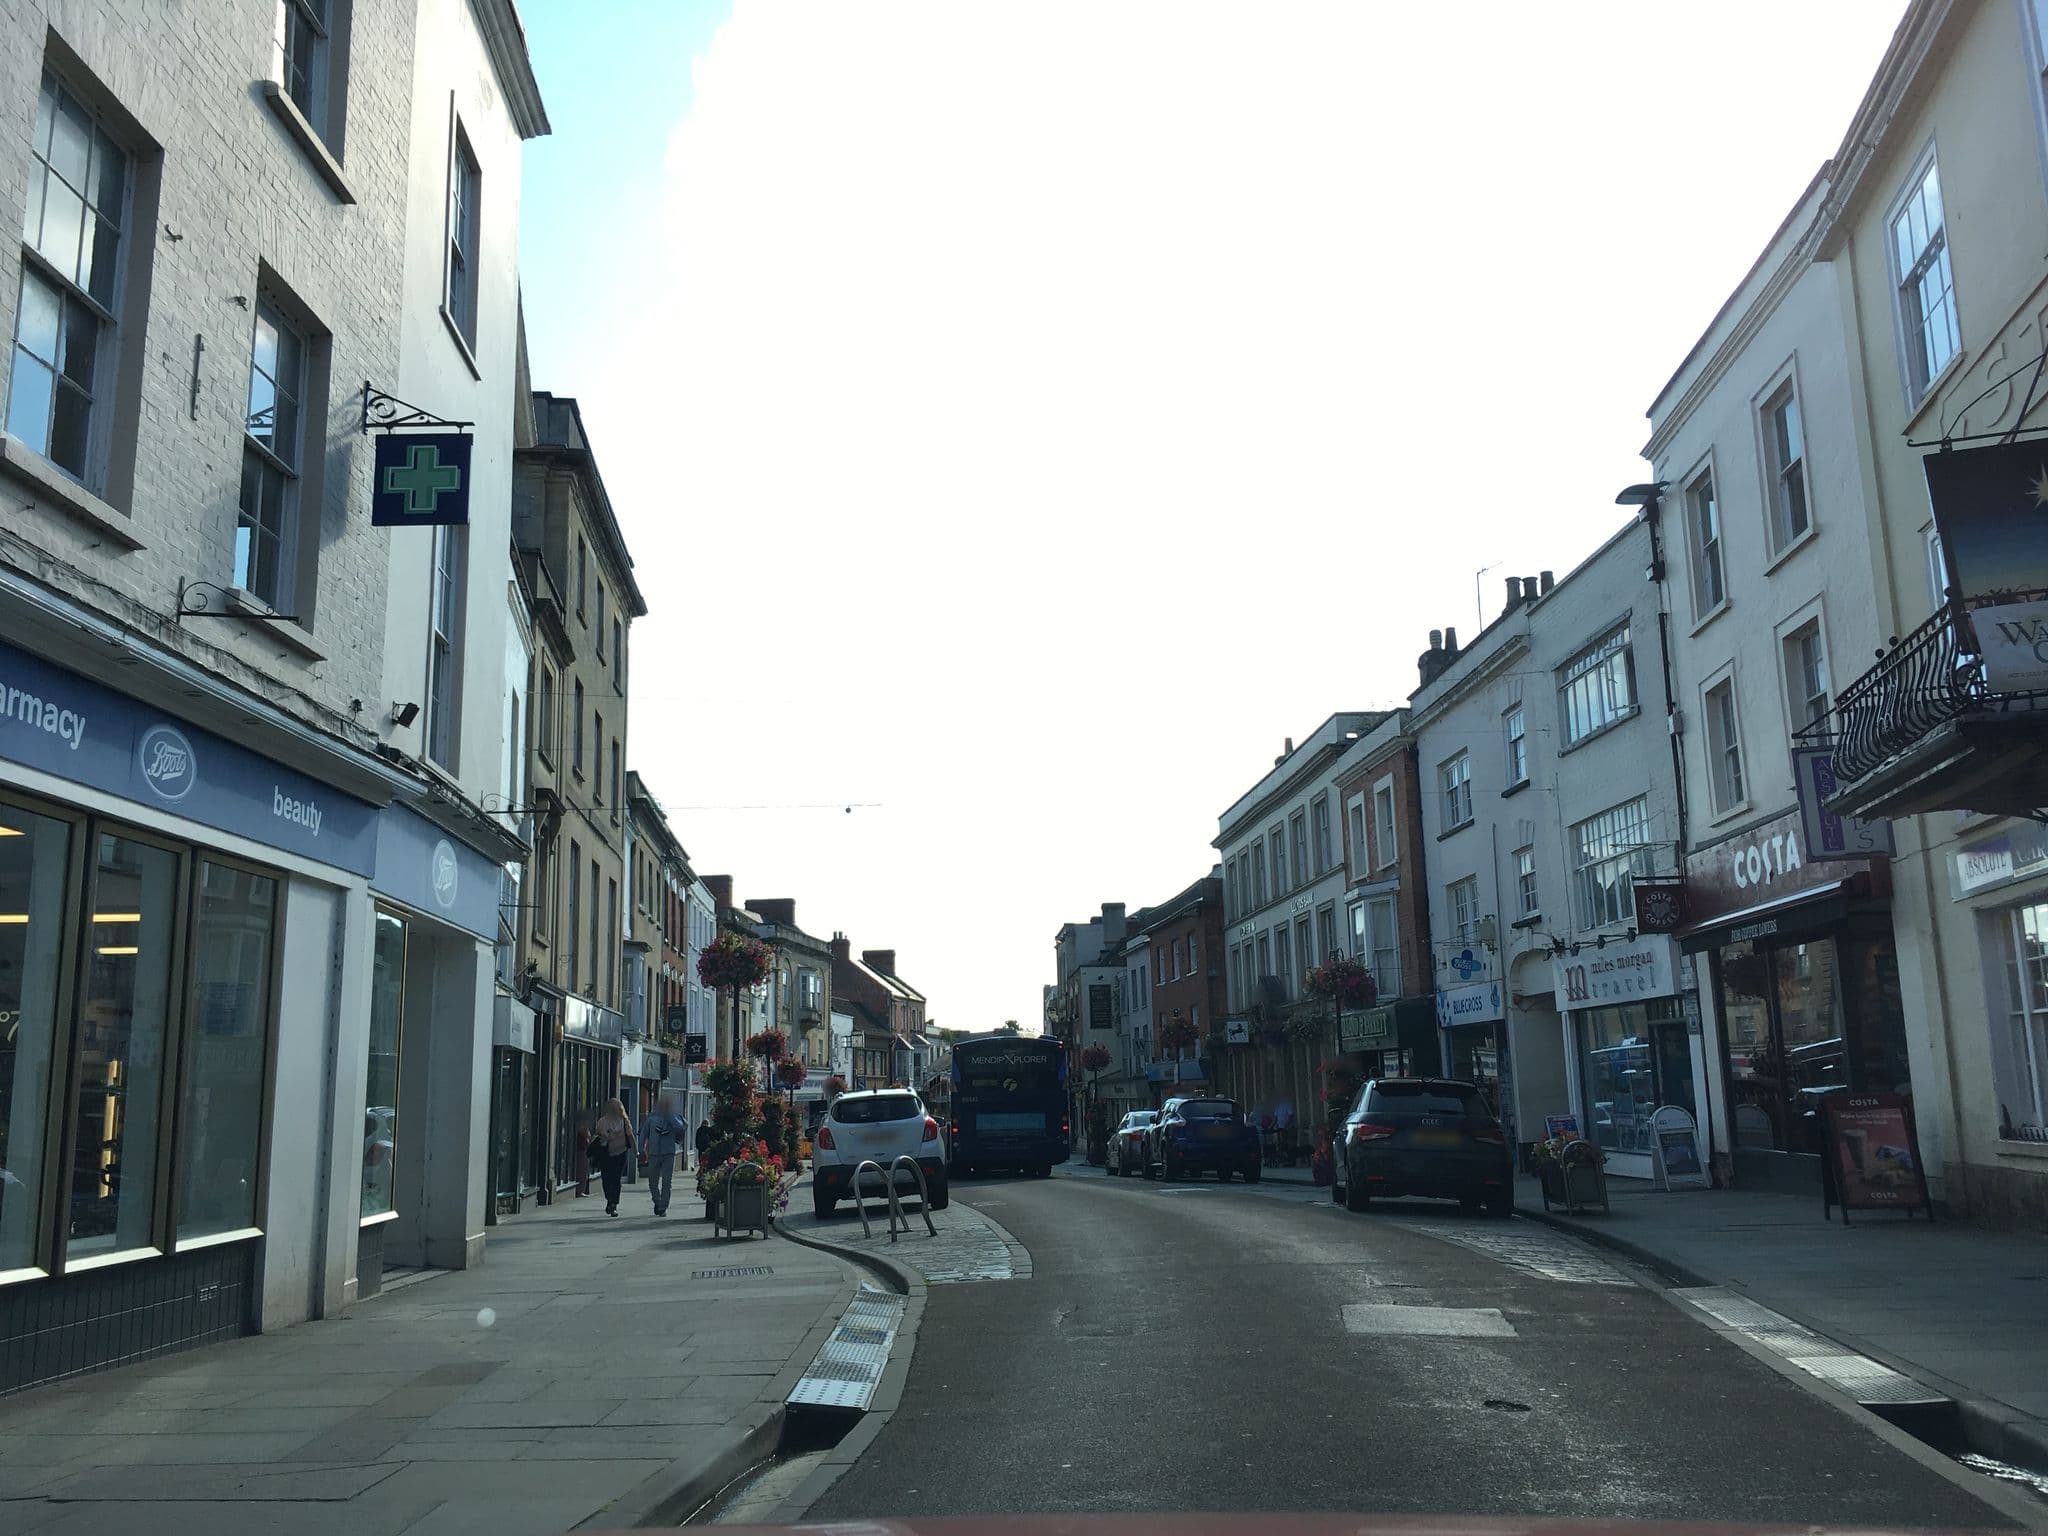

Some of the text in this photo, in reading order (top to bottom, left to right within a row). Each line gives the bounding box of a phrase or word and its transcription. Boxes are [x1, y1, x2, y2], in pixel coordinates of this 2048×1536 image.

[147, 741, 188, 781] Boots
[273, 784, 322, 837] beauty
[1734, 829, 1801, 889] COSTA
[1646, 890, 1672, 904] COSTA
[1591, 960, 1614, 974] miles
[1616, 951, 1654, 970] morgan
[1591, 965, 1657, 998] travel
[1849, 1098, 1879, 1107] COSTA
[1870, 1191, 1898, 1200] COSTA
